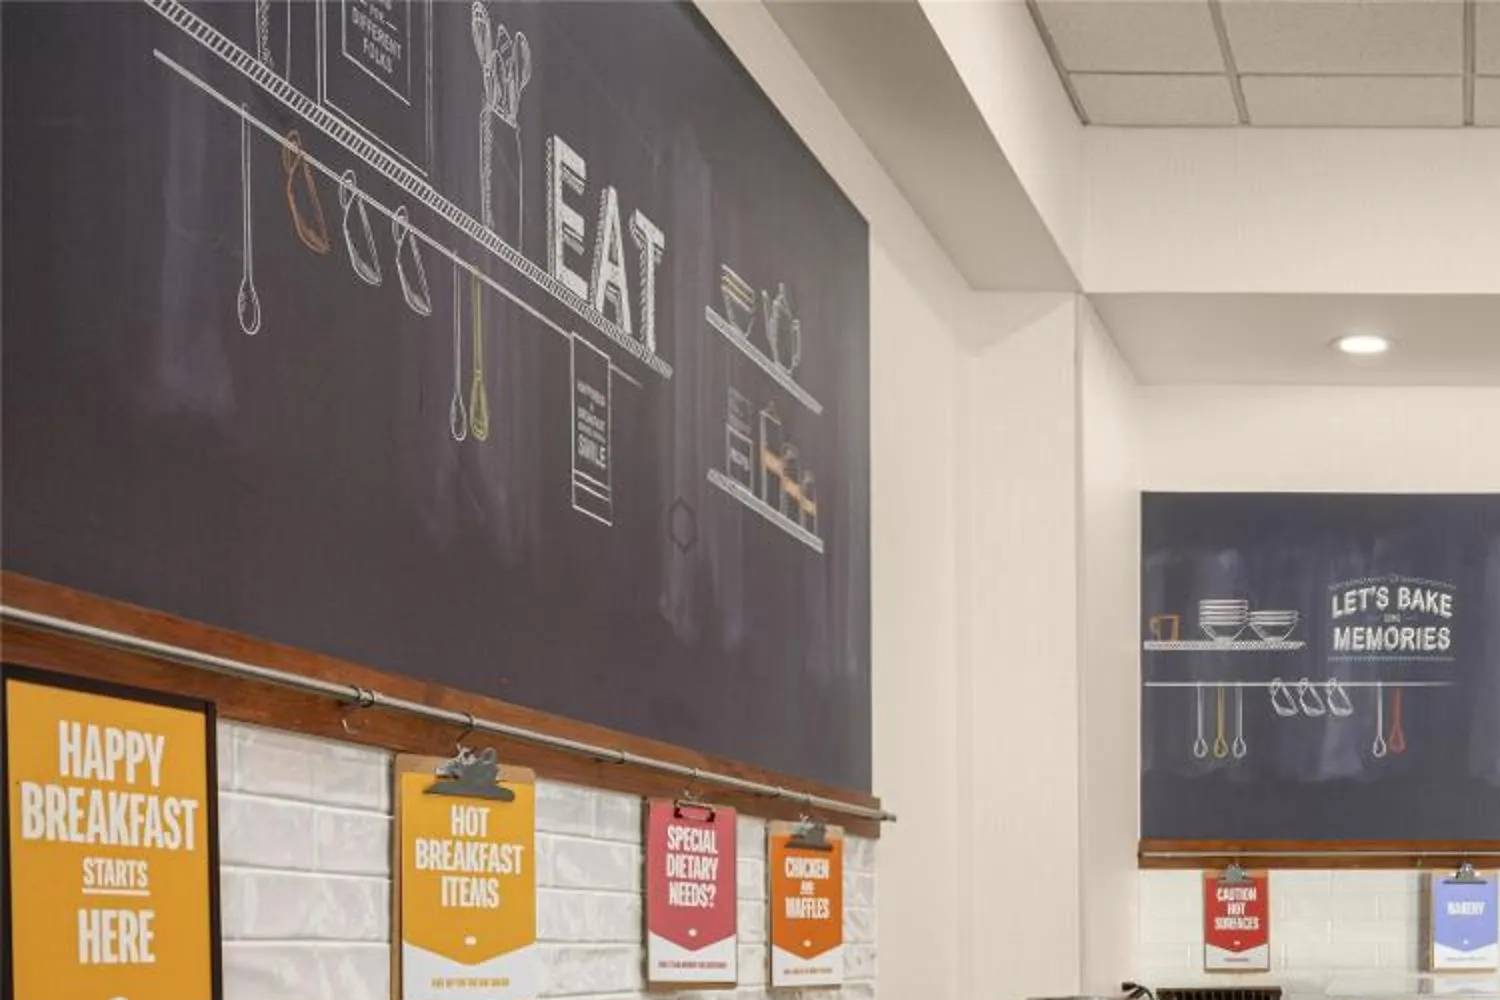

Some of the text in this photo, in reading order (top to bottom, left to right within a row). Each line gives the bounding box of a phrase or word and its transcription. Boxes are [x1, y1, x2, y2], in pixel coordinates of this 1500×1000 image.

[352, 6, 401, 60] DIFFERENT
[546, 134, 666, 354] EAT
[1332, 586, 1453, 619] LET'S BAKE
[1333, 626, 1451, 651] MEMORIES
[58, 719, 165, 788] HAPPY
[20, 781, 198, 851] BREAKFAST
[451, 805, 490, 838] HOT
[667, 825, 718, 854] SPECIAL
[415, 838, 525, 875] BREAKFAST
[666, 854, 718, 880] DIETARY
[784, 856, 830, 878] CHICKEN
[82, 857, 149, 889] STARTS
[441, 875, 499, 908] ITEMS
[668, 881, 717, 908] NEEDS?
[1216, 887, 1257, 901] CAUTION
[785, 897, 830, 919] WAFFLES
[1227, 902, 1246, 915] HOT
[1447, 901, 1486, 915] BAKERY
[77, 908, 156, 965] HERE
[1214, 916, 1260, 931] SURFACES
